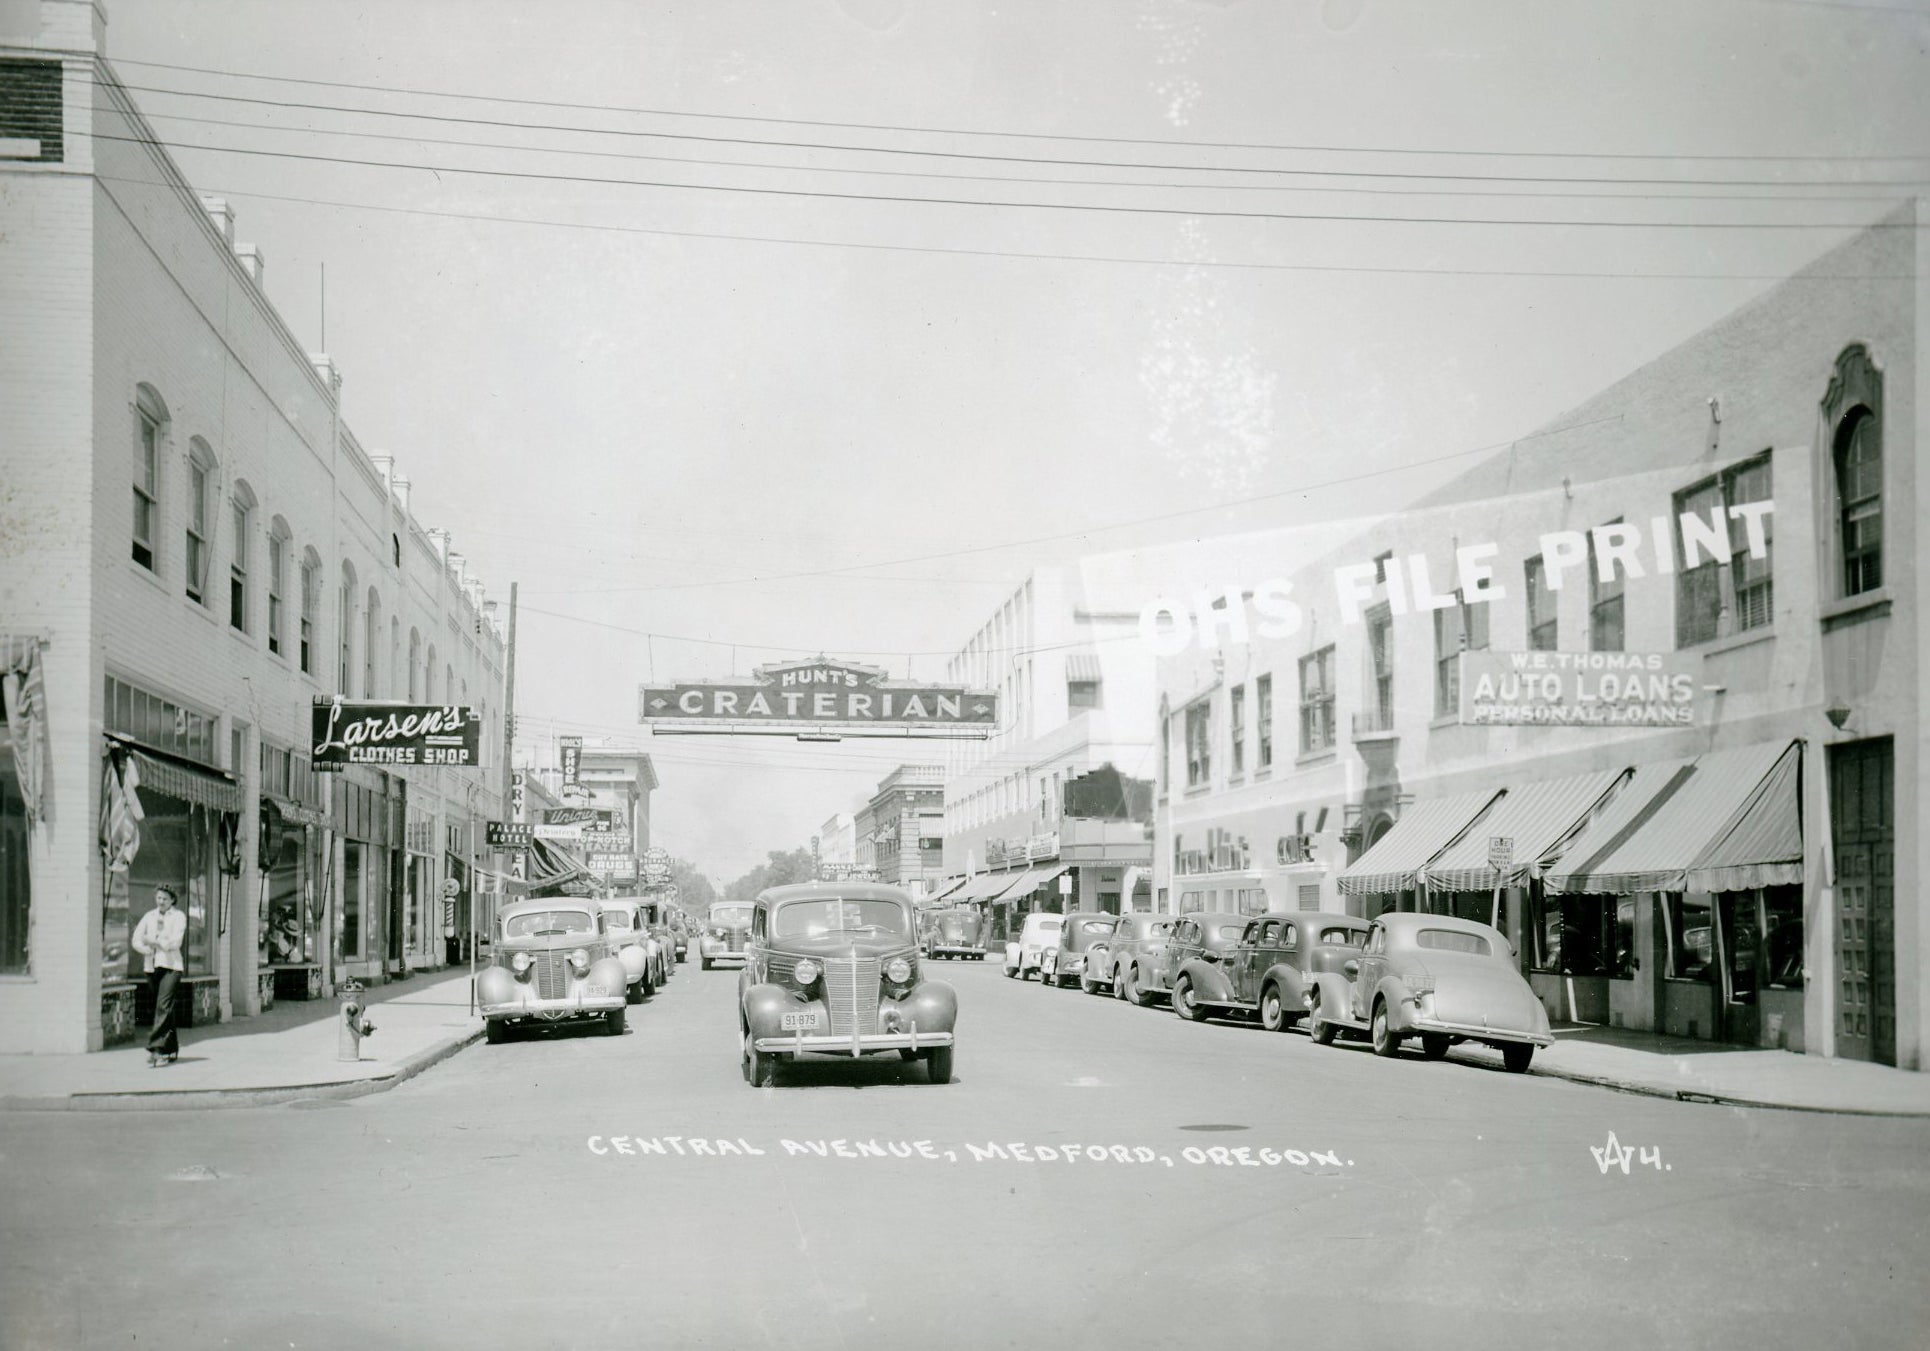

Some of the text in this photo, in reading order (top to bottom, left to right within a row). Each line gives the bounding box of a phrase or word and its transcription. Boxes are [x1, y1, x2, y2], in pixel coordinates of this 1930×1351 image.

[1556, 653, 1663, 670] THOMAS
[783, 668, 859, 689] HUNT'S
[1473, 673, 1694, 703] AUTO LOANS
[679, 690, 963, 721] CRATERIAN
[1472, 705, 1696, 723] PERSONAL LOANS
[314, 703, 467, 756] Larsen's
[349, 746, 470, 765] CLOTHES SHOP
[488, 823, 533, 834] PALACE
[492, 834, 529, 844] HOTEL
